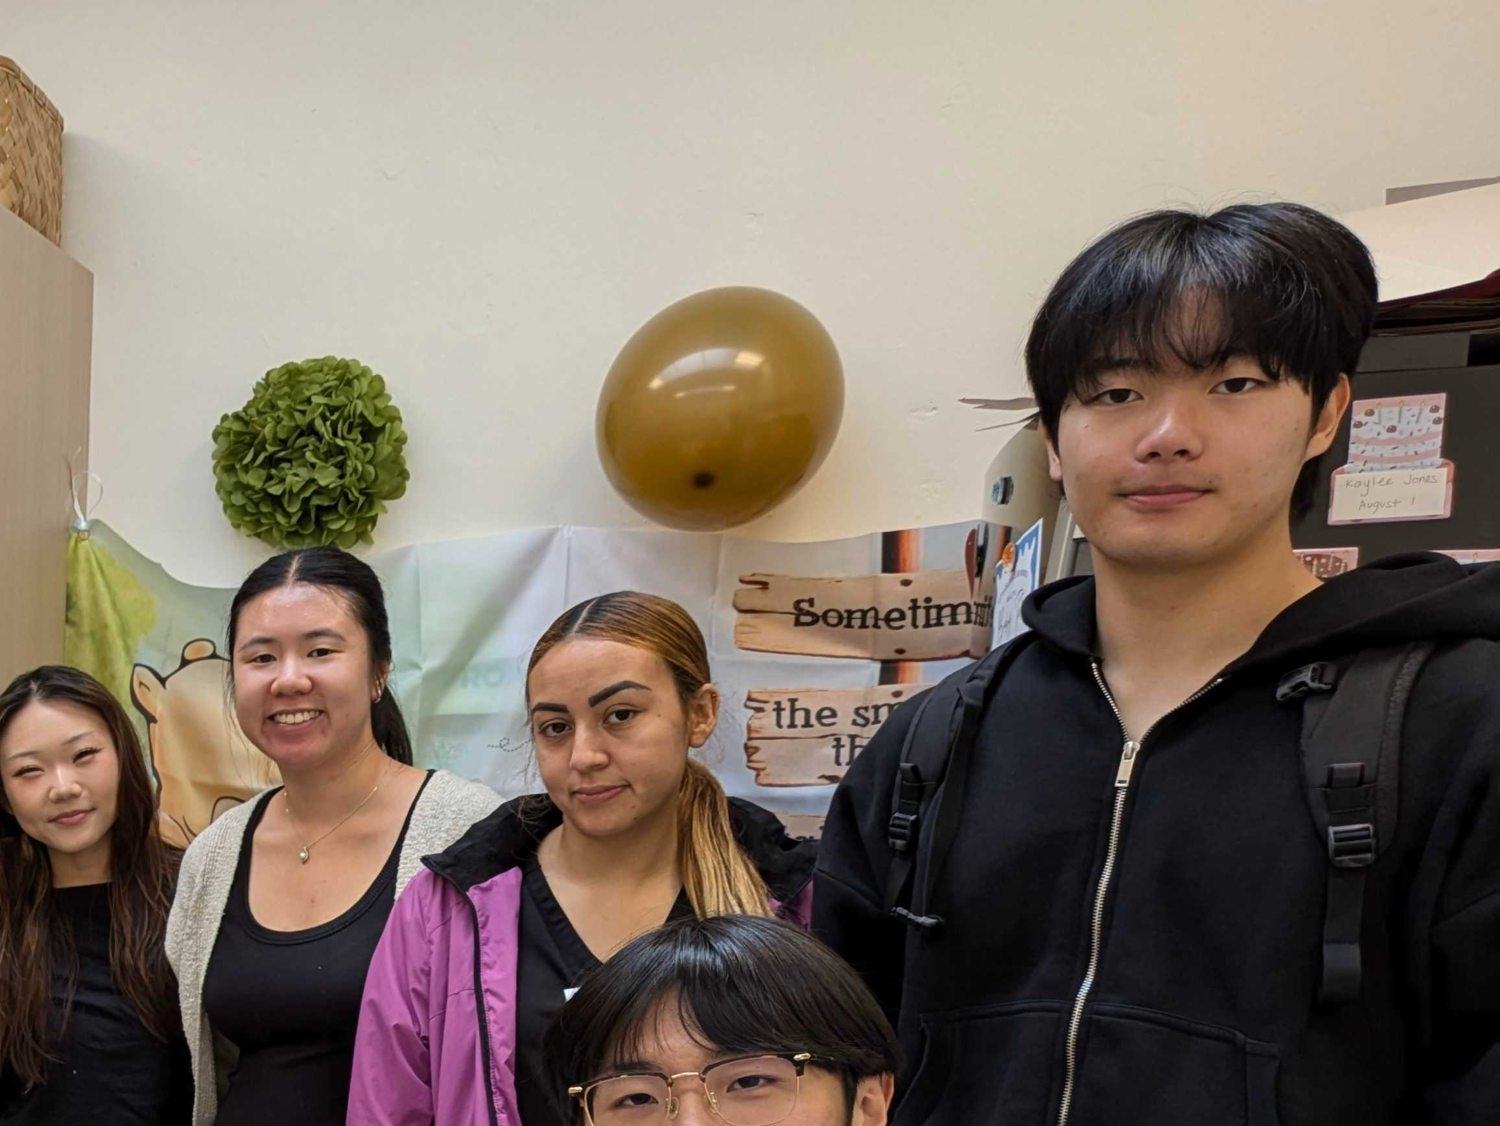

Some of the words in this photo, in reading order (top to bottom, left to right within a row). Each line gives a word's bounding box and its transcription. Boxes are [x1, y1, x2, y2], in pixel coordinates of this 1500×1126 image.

[1345, 476, 1394, 497] Kaylee
[1403, 473, 1439, 485] Jones
[1358, 499, 1402, 515] August
[772, 698, 839, 729] the
